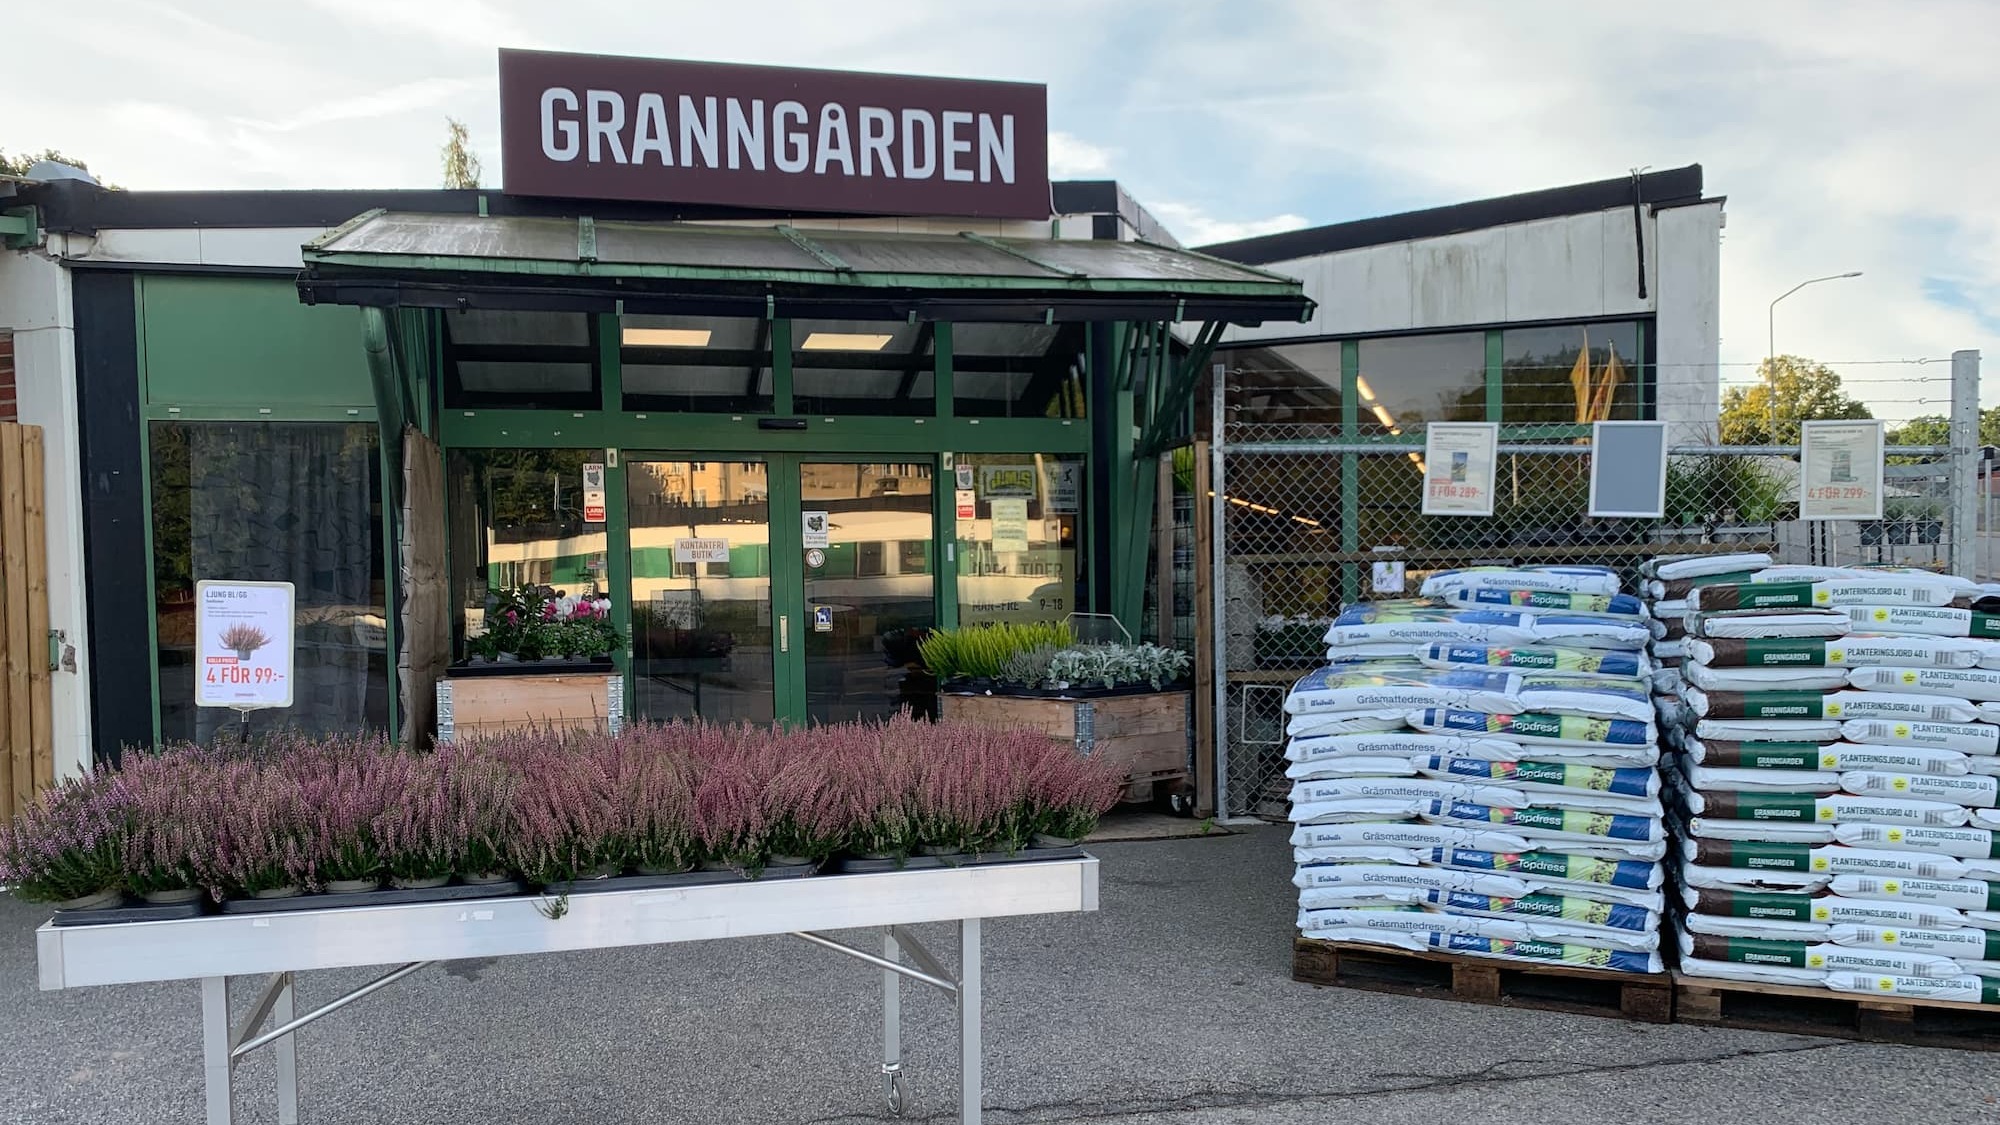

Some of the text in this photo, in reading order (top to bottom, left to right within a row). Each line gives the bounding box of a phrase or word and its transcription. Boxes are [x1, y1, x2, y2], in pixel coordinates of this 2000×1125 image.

[540, 87, 1016, 183] GRANNGÅRDEN
[680, 541, 723, 549] KONTANTFRI
[692, 551, 713, 559] BUTIK
[1832, 588, 1892, 596] PLANTERINGSJORD
[1529, 594, 1569, 606] Topdress
[1891, 608, 1952, 619] PLANTERINGSJORD
[1389, 629, 1459, 638] Gräsmattedress
[1510, 653, 1554, 665] Topdress
[1848, 648, 1913, 658] PLANTERINGSJORD
[207, 666, 284, 683] 4 FÖR 99:-
[1920, 671, 1986, 682] PLANTERINGSJORD
[1988, 675, 1996, 683] 40
[1357, 695, 1435, 705] Gräsmattedress
[1845, 702, 1910, 711] PLANTERINGSJORD
[1511, 719, 1559, 733] Topdress
[1913, 724, 1978, 736] PLANTERINGSJORD
[1980, 729, 1989, 737] 40
[1357, 743, 1435, 752] Gräsmattedress
[1840, 754, 1905, 764] PLANTERINGSJORD
[1515, 767, 1563, 780] Topdress
[1911, 777, 1977, 789] PLANTERINGSJORD
[1979, 782, 1987, 790] 40
[1361, 786, 1440, 797] Gräsmattedress
[1838, 806, 1902, 816] PLANTERINGSJORD
[1513, 811, 1561, 825] Topdress
[1362, 832, 1441, 843] Gräsmattedress
[1906, 829, 1971, 841] PLANTERINGSJORD
[1973, 834, 1982, 842] 40
[1518, 859, 1566, 872] Topdress
[1832, 858, 1896, 868] PLANTERINGSJORD
[1898, 861, 1907, 869] 40
[1363, 873, 1440, 886] Gräsmattedress
[1903, 881, 1968, 893] PLANTERINGSJORD
[1514, 899, 1560, 913] Topdress
[1833, 908, 1897, 918] PLANTERINGSJORD
[1367, 919, 1446, 931] Gräsmattedress
[1900, 931, 1966, 943] PLANTERINGSJORD
[1514, 942, 1561, 955] Topdress
[1827, 955, 1891, 967] PLANTERINGSJORD
[1897, 978, 1962, 988] PLANTERINGSJORD
